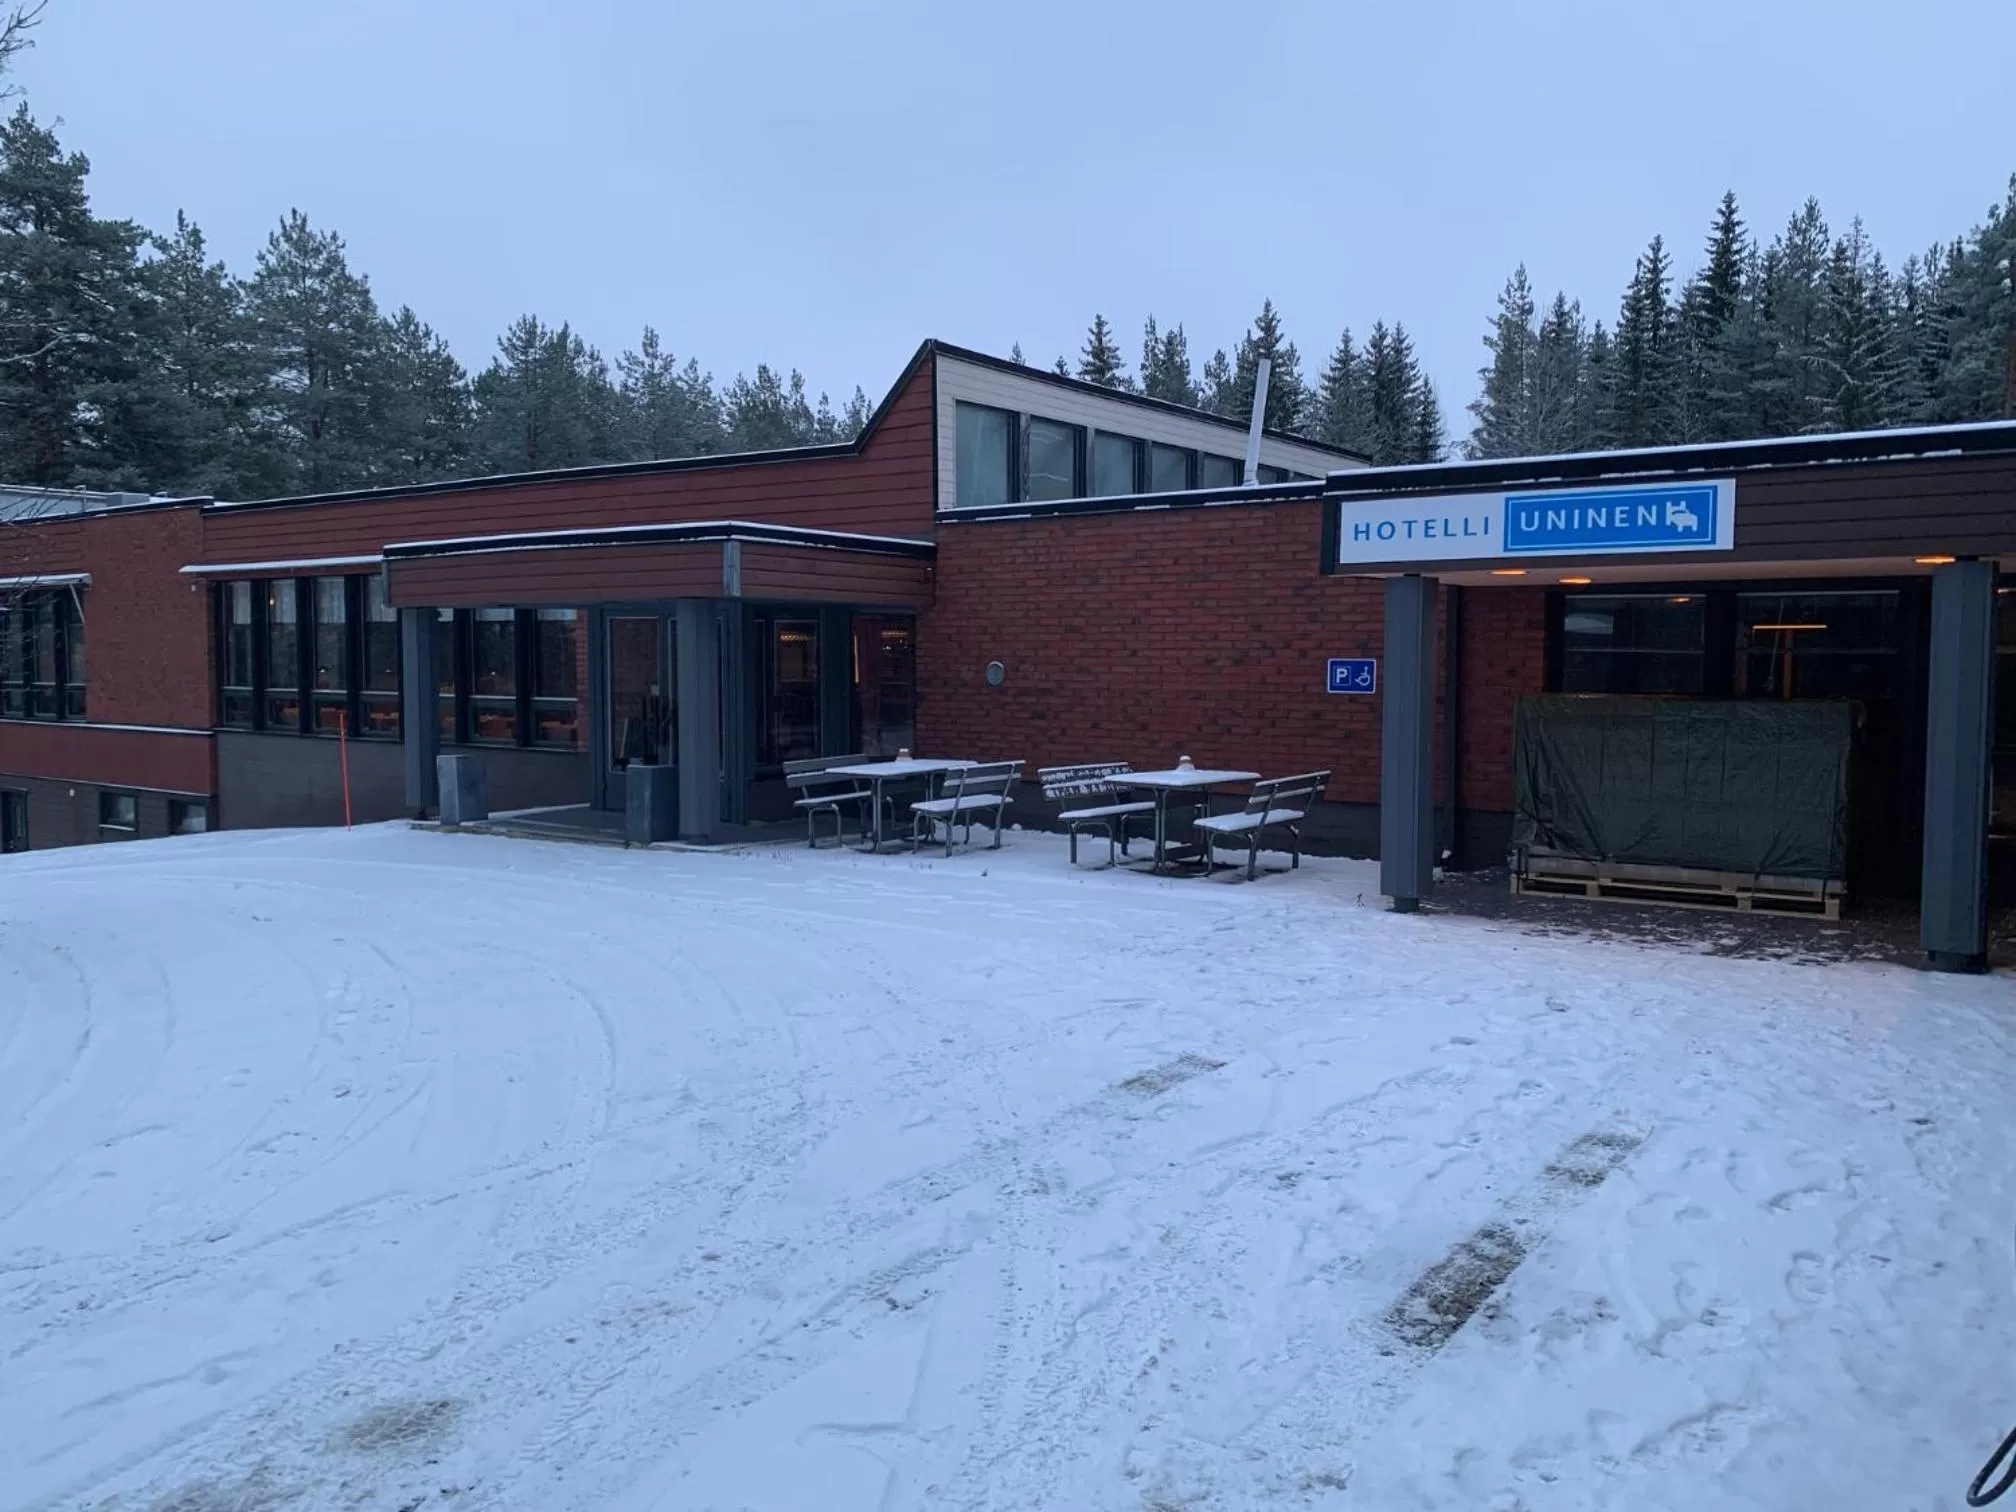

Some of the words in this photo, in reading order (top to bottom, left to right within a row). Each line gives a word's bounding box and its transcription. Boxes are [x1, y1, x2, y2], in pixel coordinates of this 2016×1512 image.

[1353, 516, 1490, 541] HOTELLI
[1520, 505, 1657, 532] UNINEN
[1336, 668, 1348, 683] P
